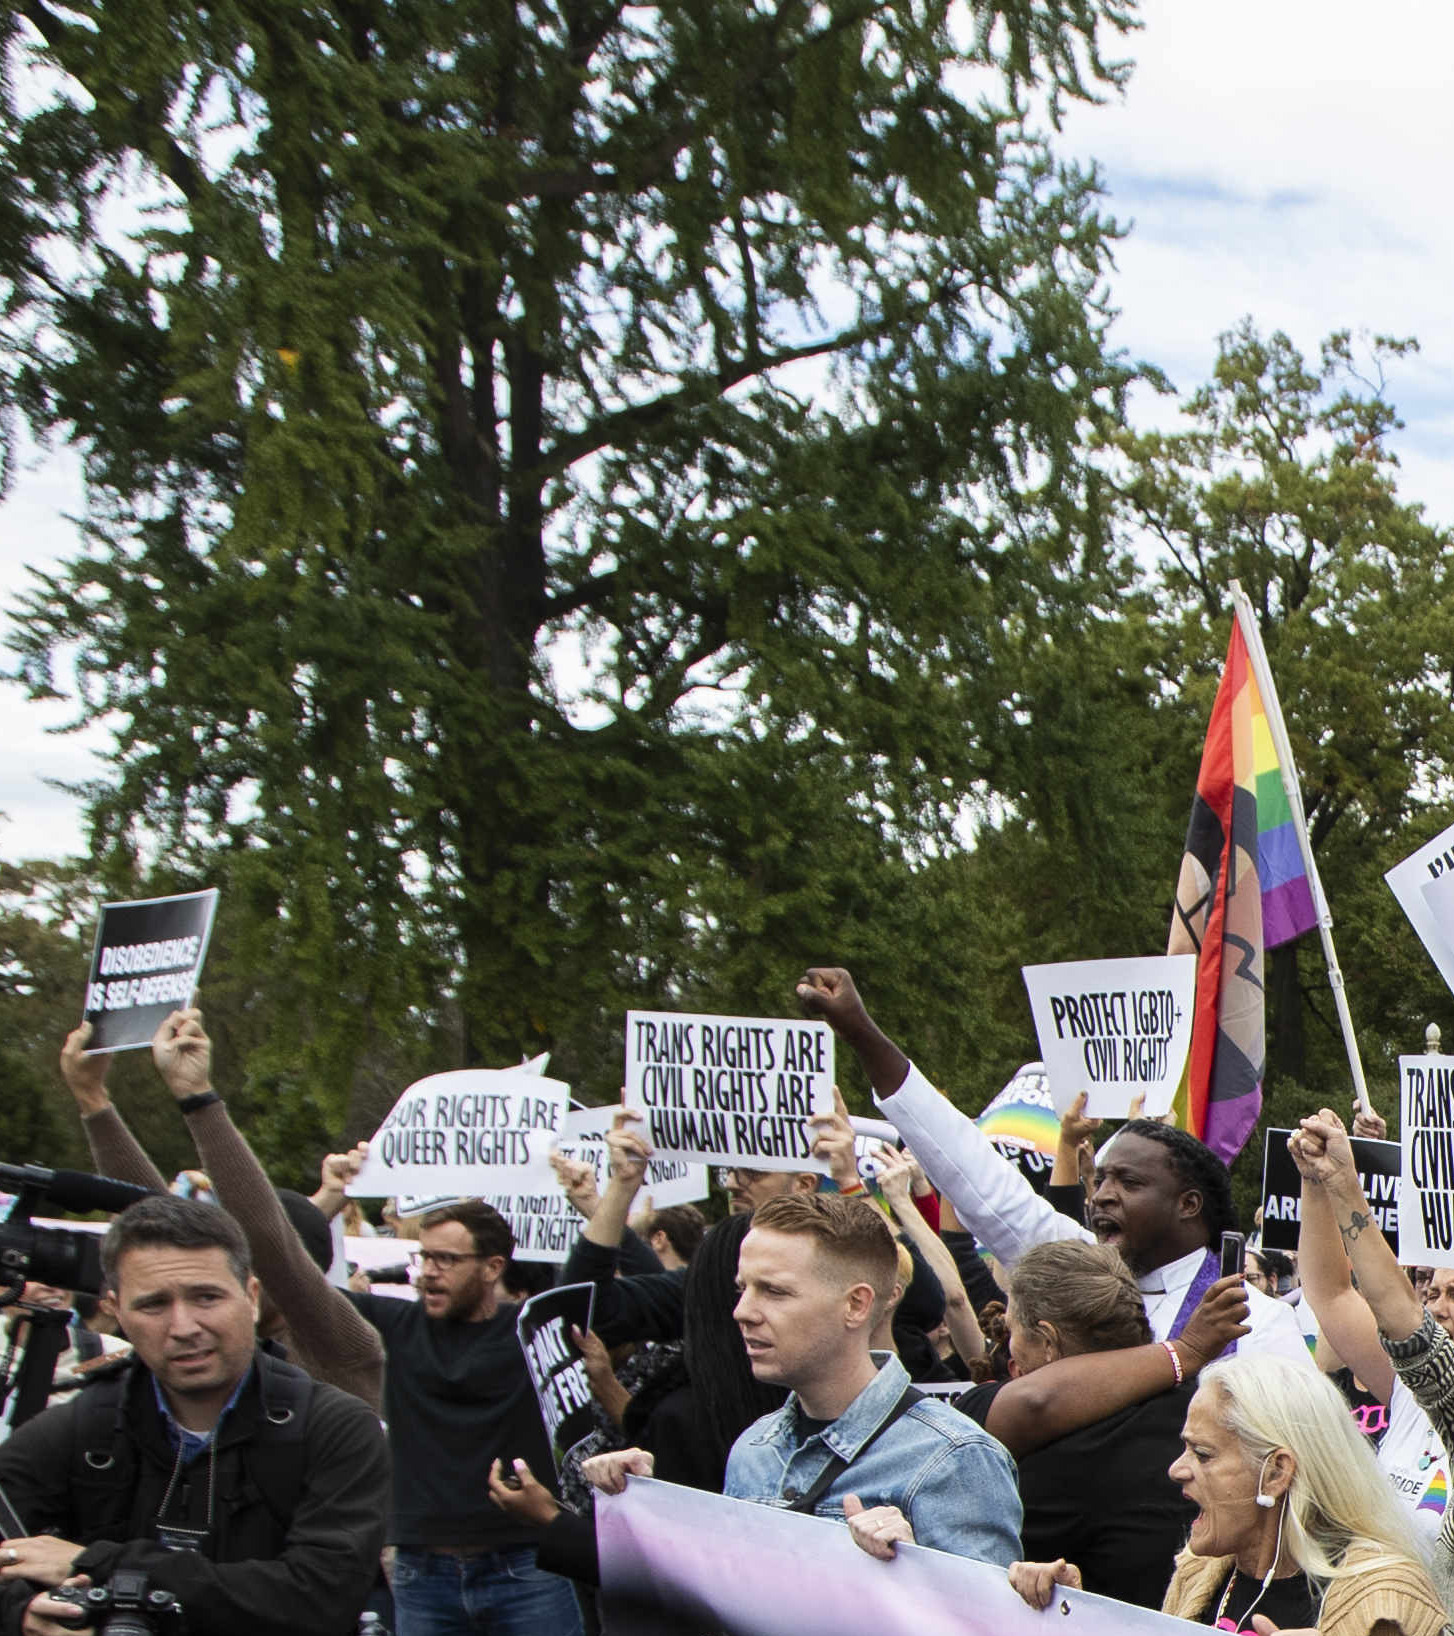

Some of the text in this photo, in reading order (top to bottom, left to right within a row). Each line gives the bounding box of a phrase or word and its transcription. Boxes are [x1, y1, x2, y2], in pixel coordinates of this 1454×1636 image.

[100, 936, 200, 976] DISOBEDIENCE
[86, 982, 106, 1011] IS
[1050, 990, 1182, 1039] PROTECT LGBTQ+
[635, 1020, 826, 1073] TRANS RIGHTS ARE
[1083, 1037, 1171, 1082] CIVIL RIGHTS
[435, 1095, 512, 1128] RIGHTS
[518, 1096, 559, 1132] ARE
[643, 1065, 816, 1116] CIVIL RIGHTS ARE
[381, 1130, 531, 1168] QUEER RIGHTS
[650, 1108, 730, 1154] HUMAN
[733, 1114, 811, 1159] RIGHTS
[553, 1357, 593, 1415] FRE
